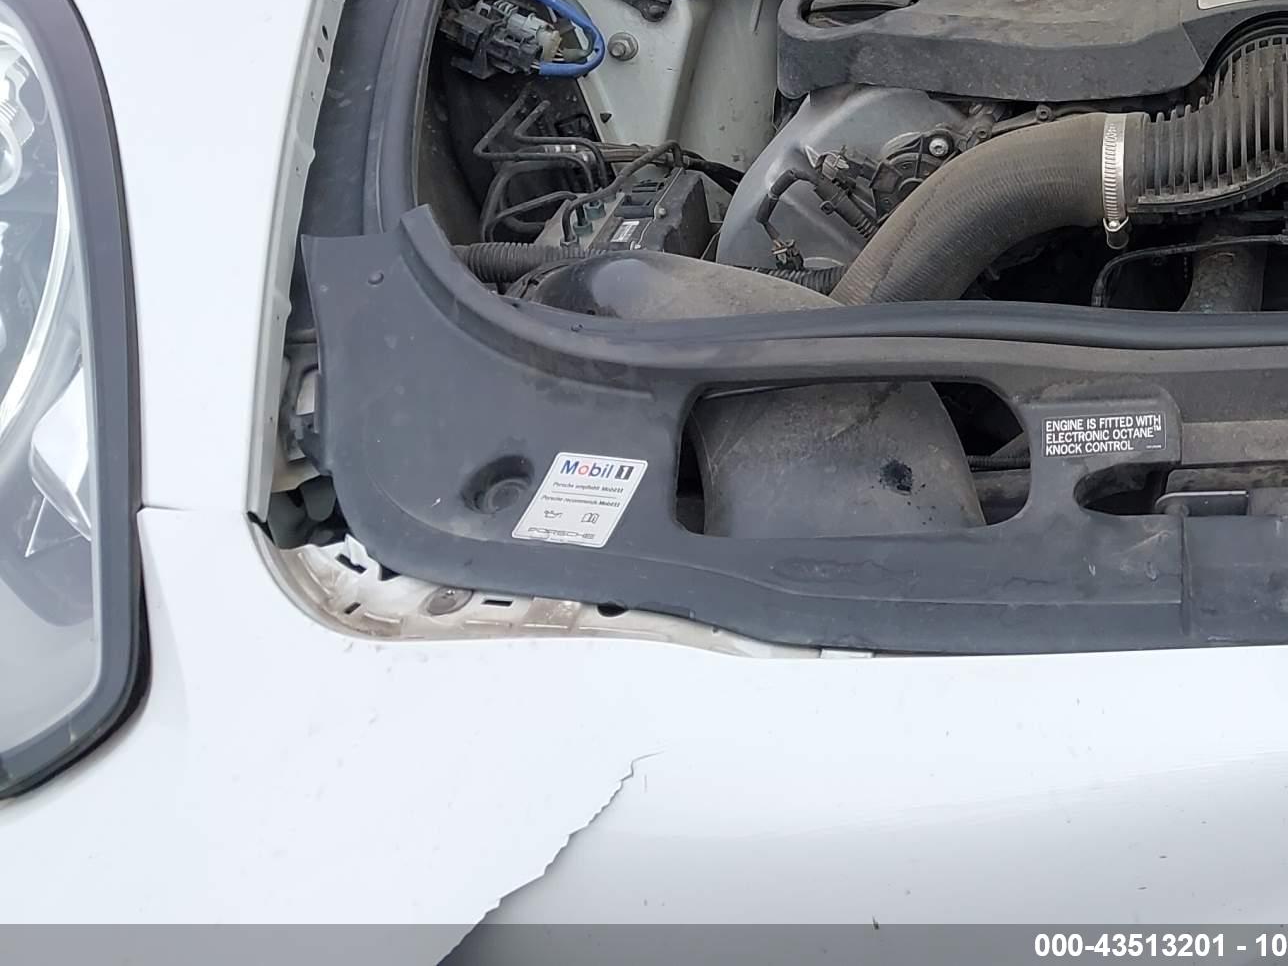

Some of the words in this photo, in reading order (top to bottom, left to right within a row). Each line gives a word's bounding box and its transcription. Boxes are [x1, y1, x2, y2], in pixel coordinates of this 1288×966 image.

[1045, 419, 1084, 432] ENGINE
[1086, 418, 1097, 430] IS
[1099, 416, 1134, 429] FITTED
[1135, 414, 1161, 427] WITH
[1045, 430, 1110, 444] ELECTRONIC
[1045, 443, 1082, 456] KNOCK
[1084, 440, 1134, 453] CONTROL
[560, 460, 614, 479] Mobil
[615, 465, 634, 480] 1
